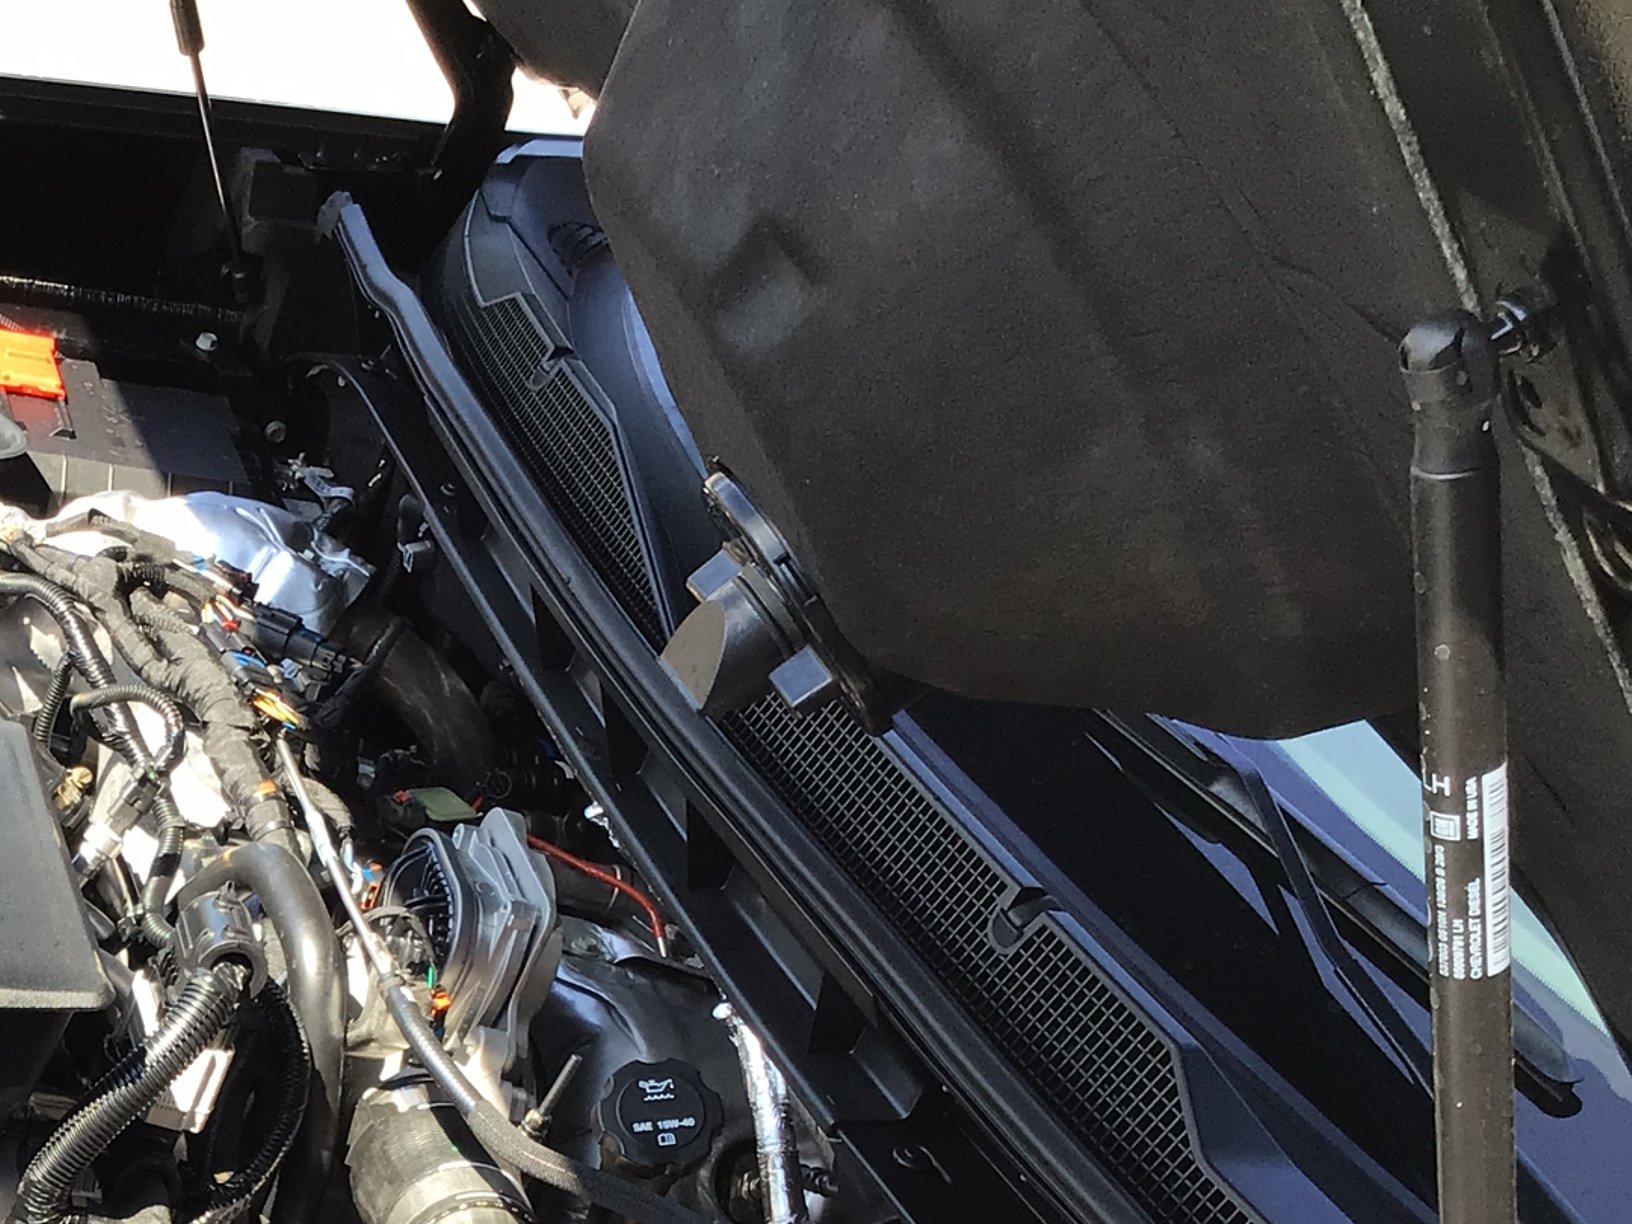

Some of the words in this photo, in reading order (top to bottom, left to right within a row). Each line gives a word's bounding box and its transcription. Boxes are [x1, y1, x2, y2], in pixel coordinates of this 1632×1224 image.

[1465, 776, 1478, 799] USA
[1466, 799, 1478, 811] IN
[1466, 811, 1479, 839] MADE
[1467, 877, 1482, 917] DIESEL
[1468, 918, 1483, 980] CHEVROLET
[632, 1120, 654, 1133] SAE
